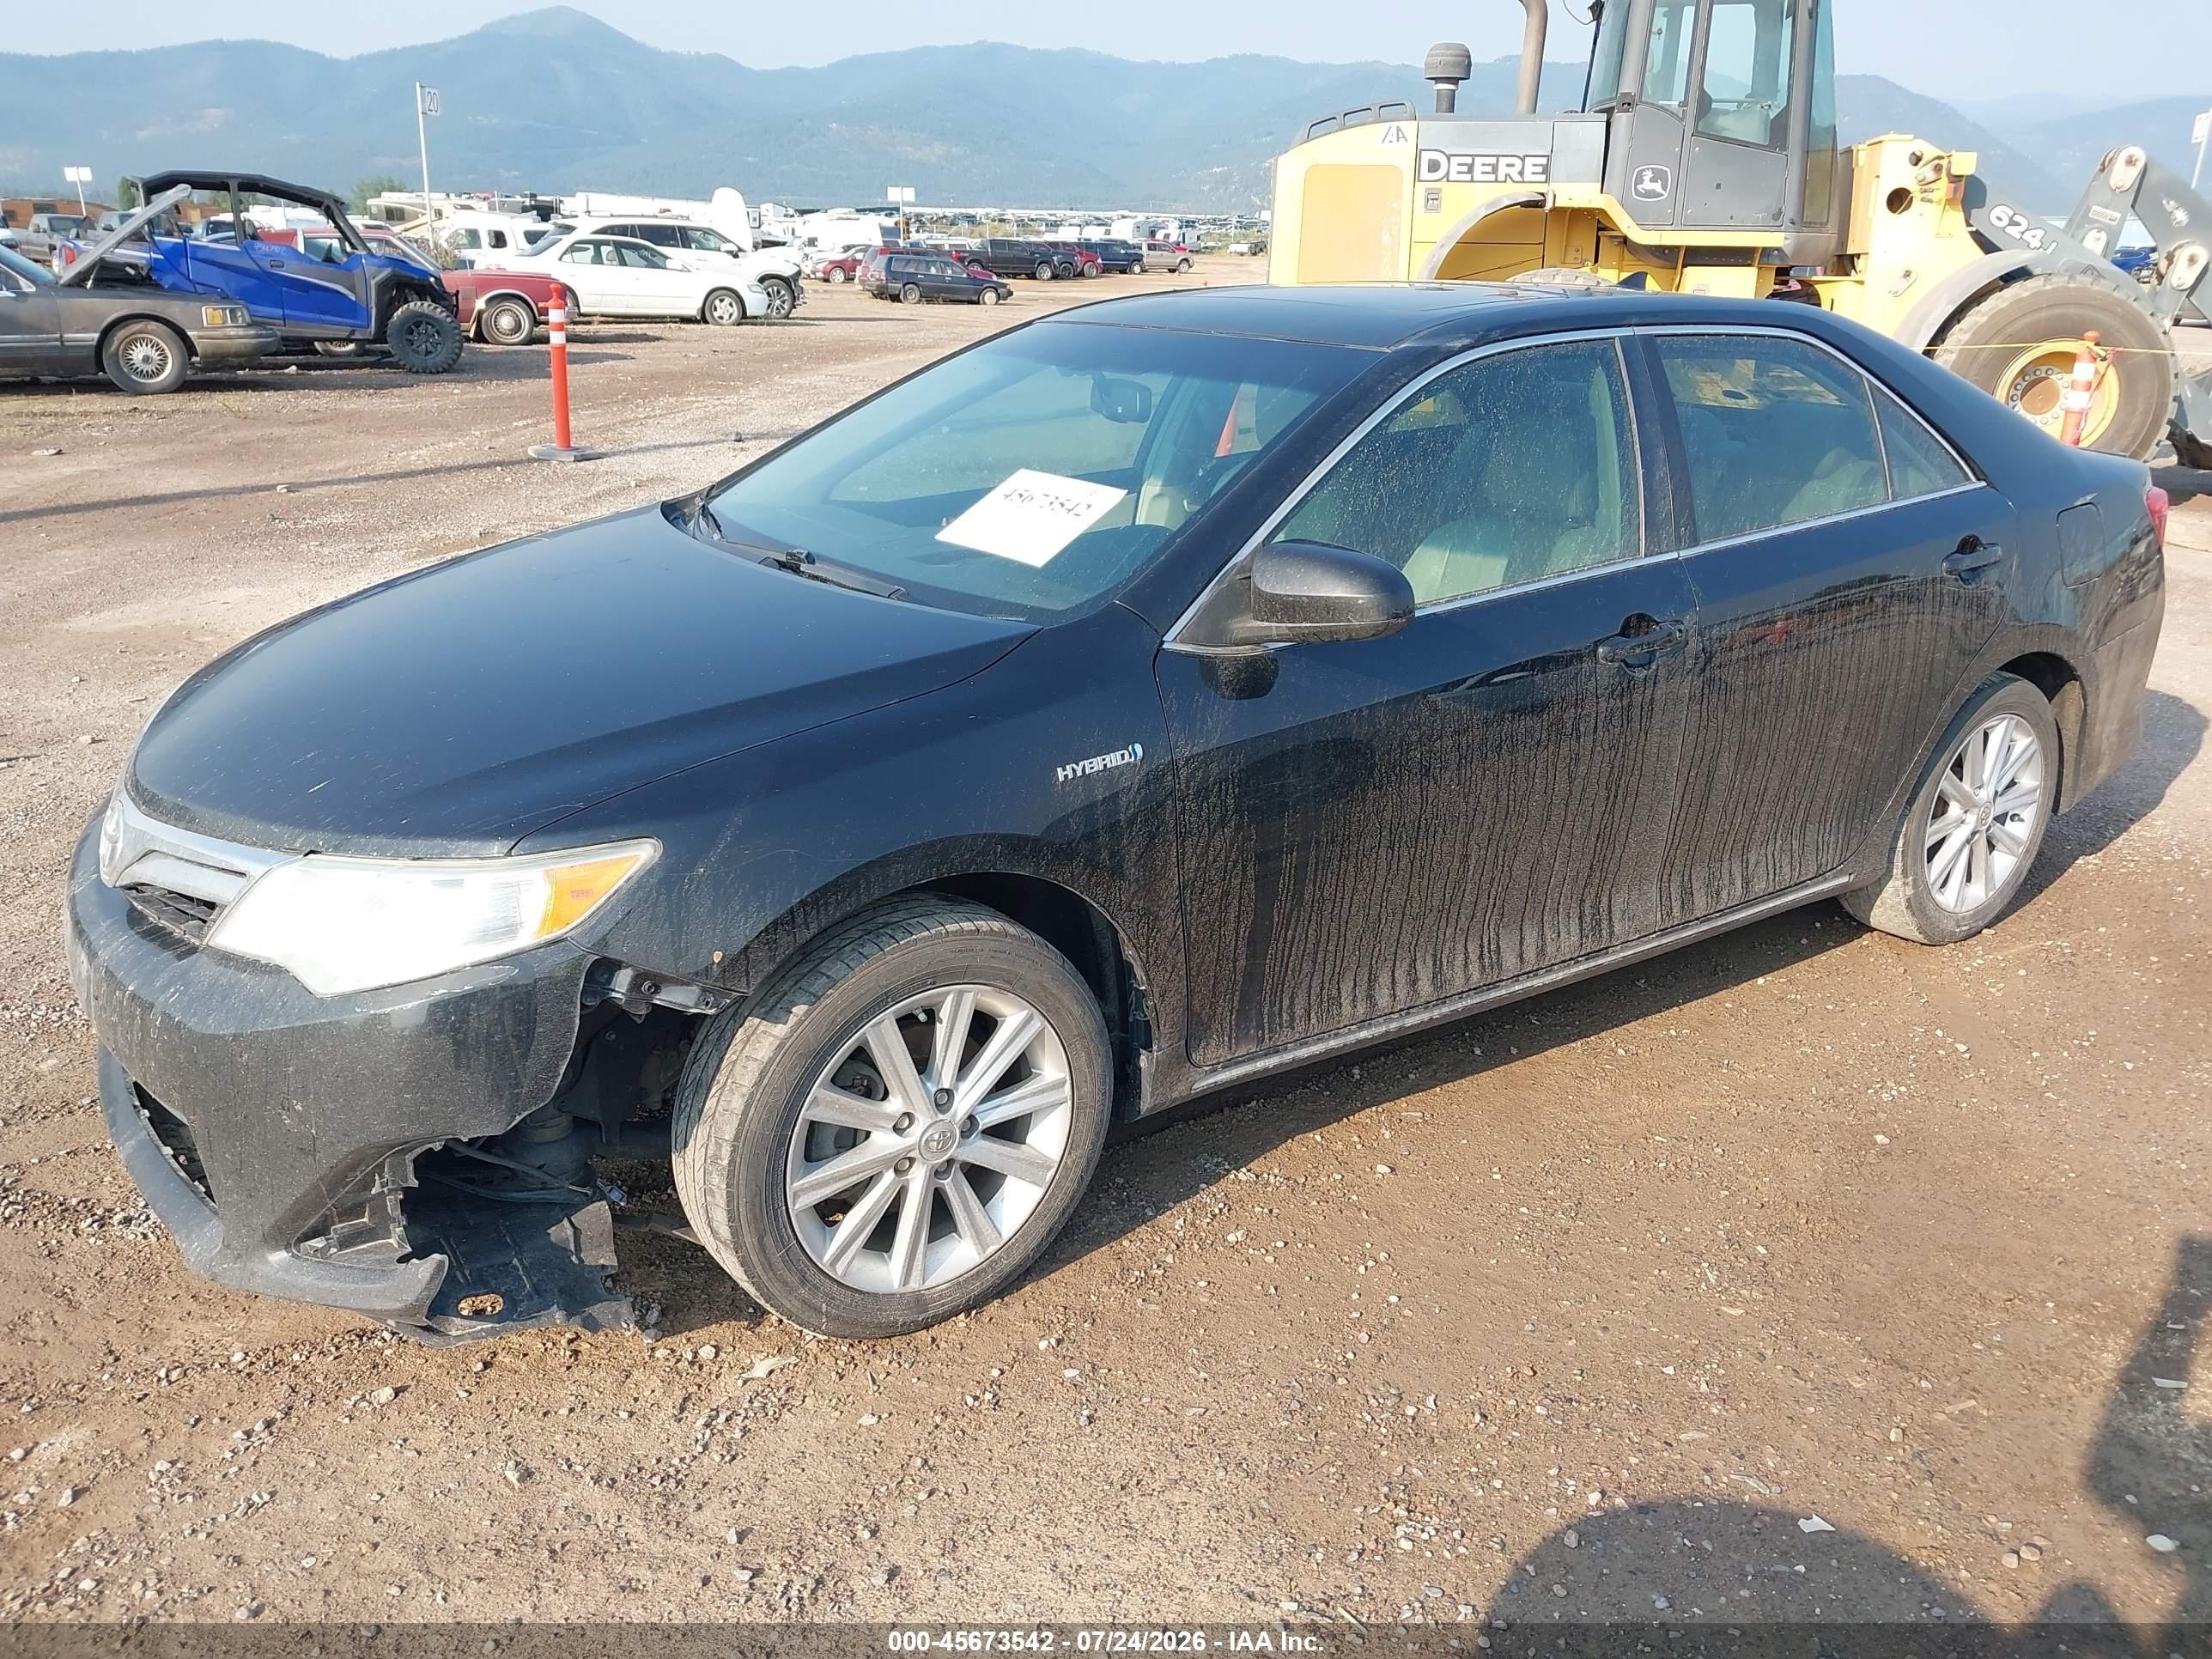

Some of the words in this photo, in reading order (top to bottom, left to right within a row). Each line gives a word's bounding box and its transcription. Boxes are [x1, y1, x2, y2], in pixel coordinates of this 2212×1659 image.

[427, 90, 439, 113] 20
[1417, 149, 1550, 183] DEERE
[1056, 749, 1133, 782] HYBRID
